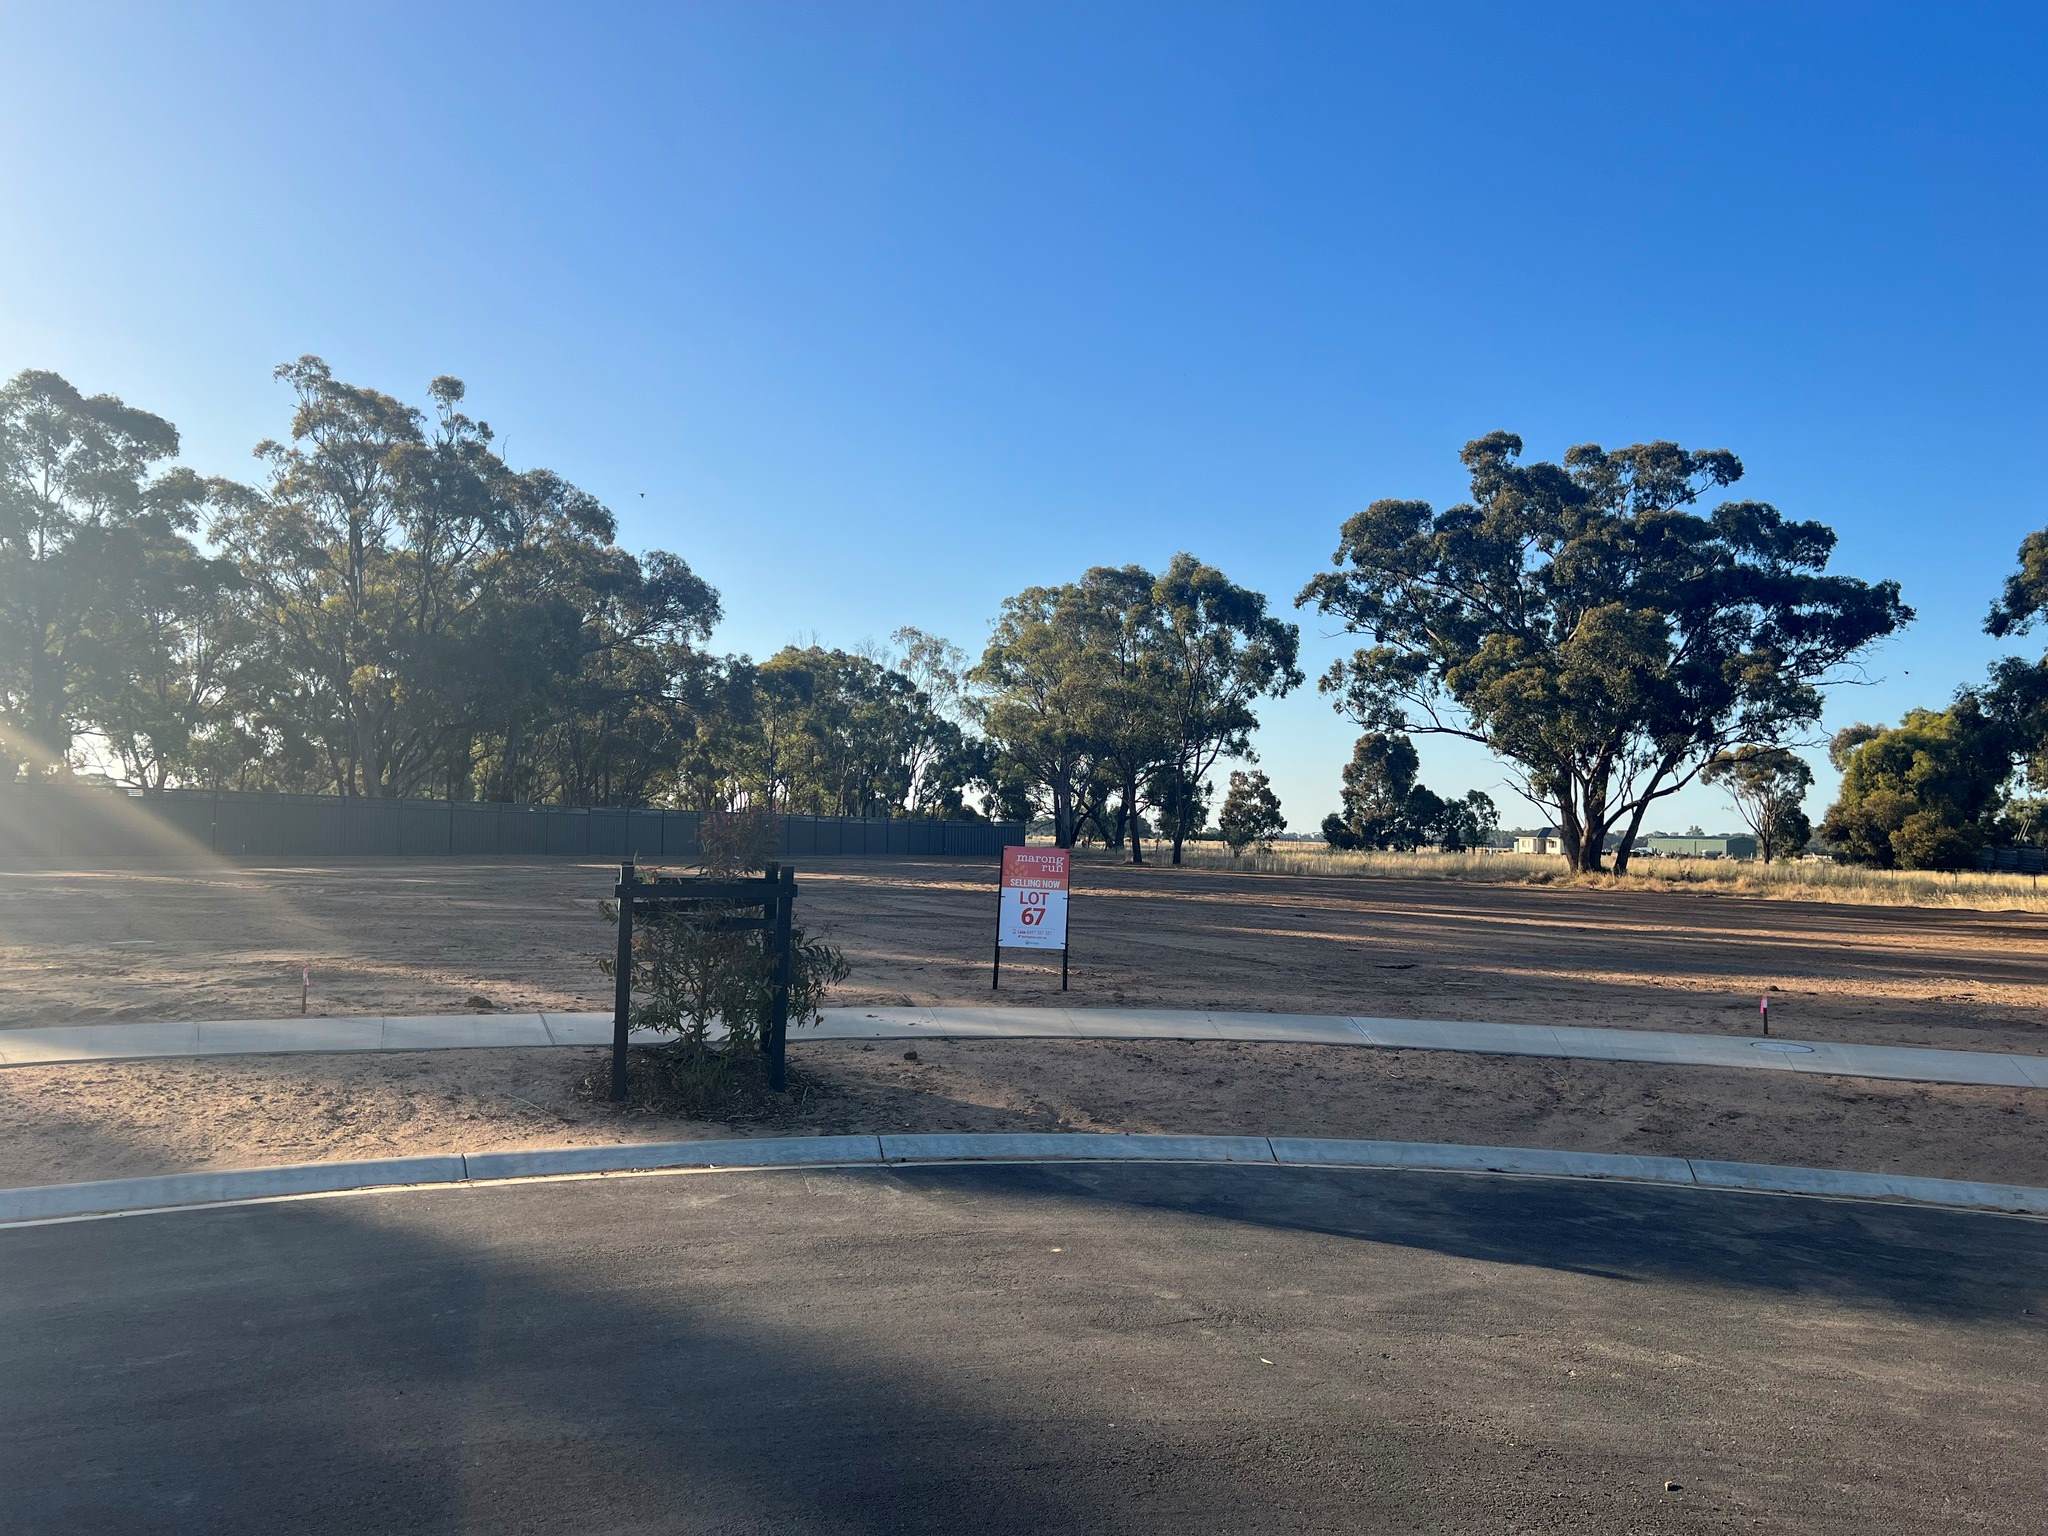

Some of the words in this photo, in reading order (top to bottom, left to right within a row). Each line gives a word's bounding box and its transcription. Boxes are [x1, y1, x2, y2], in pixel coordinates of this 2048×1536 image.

[1016, 854, 1064, 866] marong
[1041, 864, 1064, 873] run
[1010, 878, 1040, 888] SELLING
[1043, 879, 1061, 889] NOW
[1020, 891, 1049, 905] LOT
[1021, 907, 1046, 925] 67
